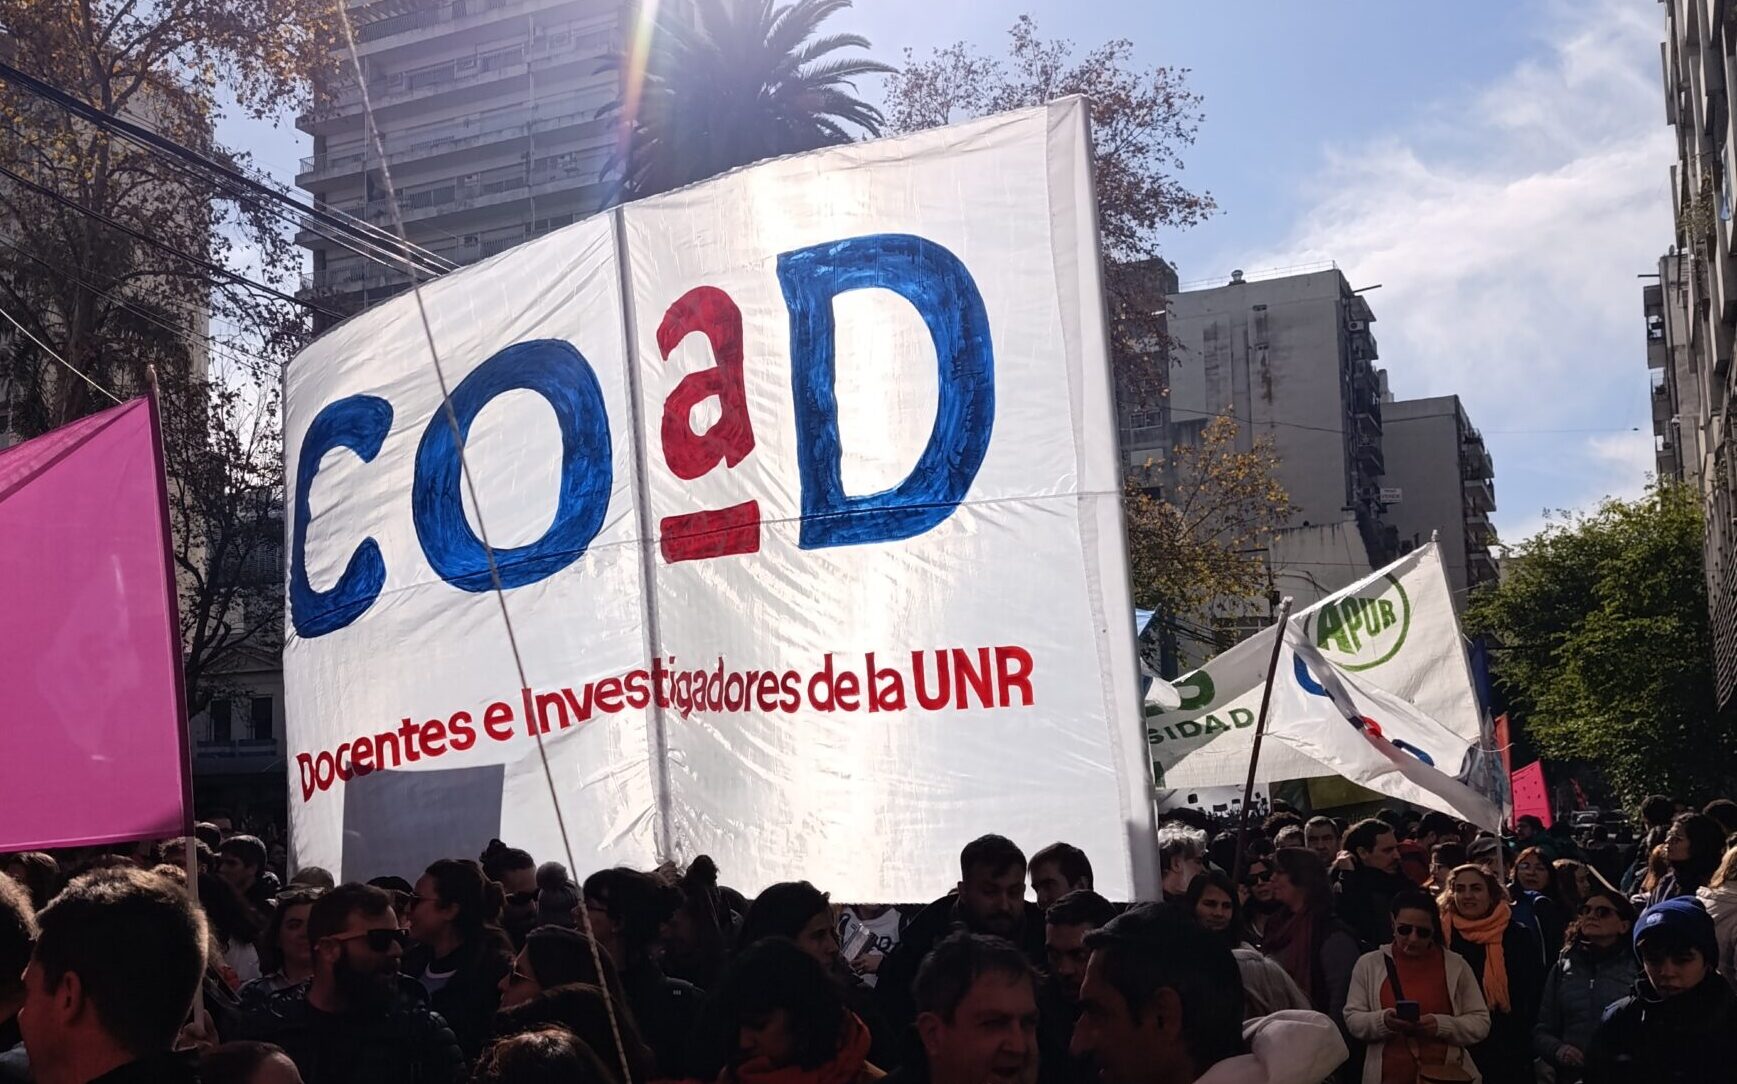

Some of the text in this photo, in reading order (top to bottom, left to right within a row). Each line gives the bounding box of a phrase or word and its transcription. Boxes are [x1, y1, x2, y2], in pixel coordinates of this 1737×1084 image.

[1317, 597, 1397, 656] APUR
[297, 646, 1035, 803] Docentes e Investigadores de la UNR
